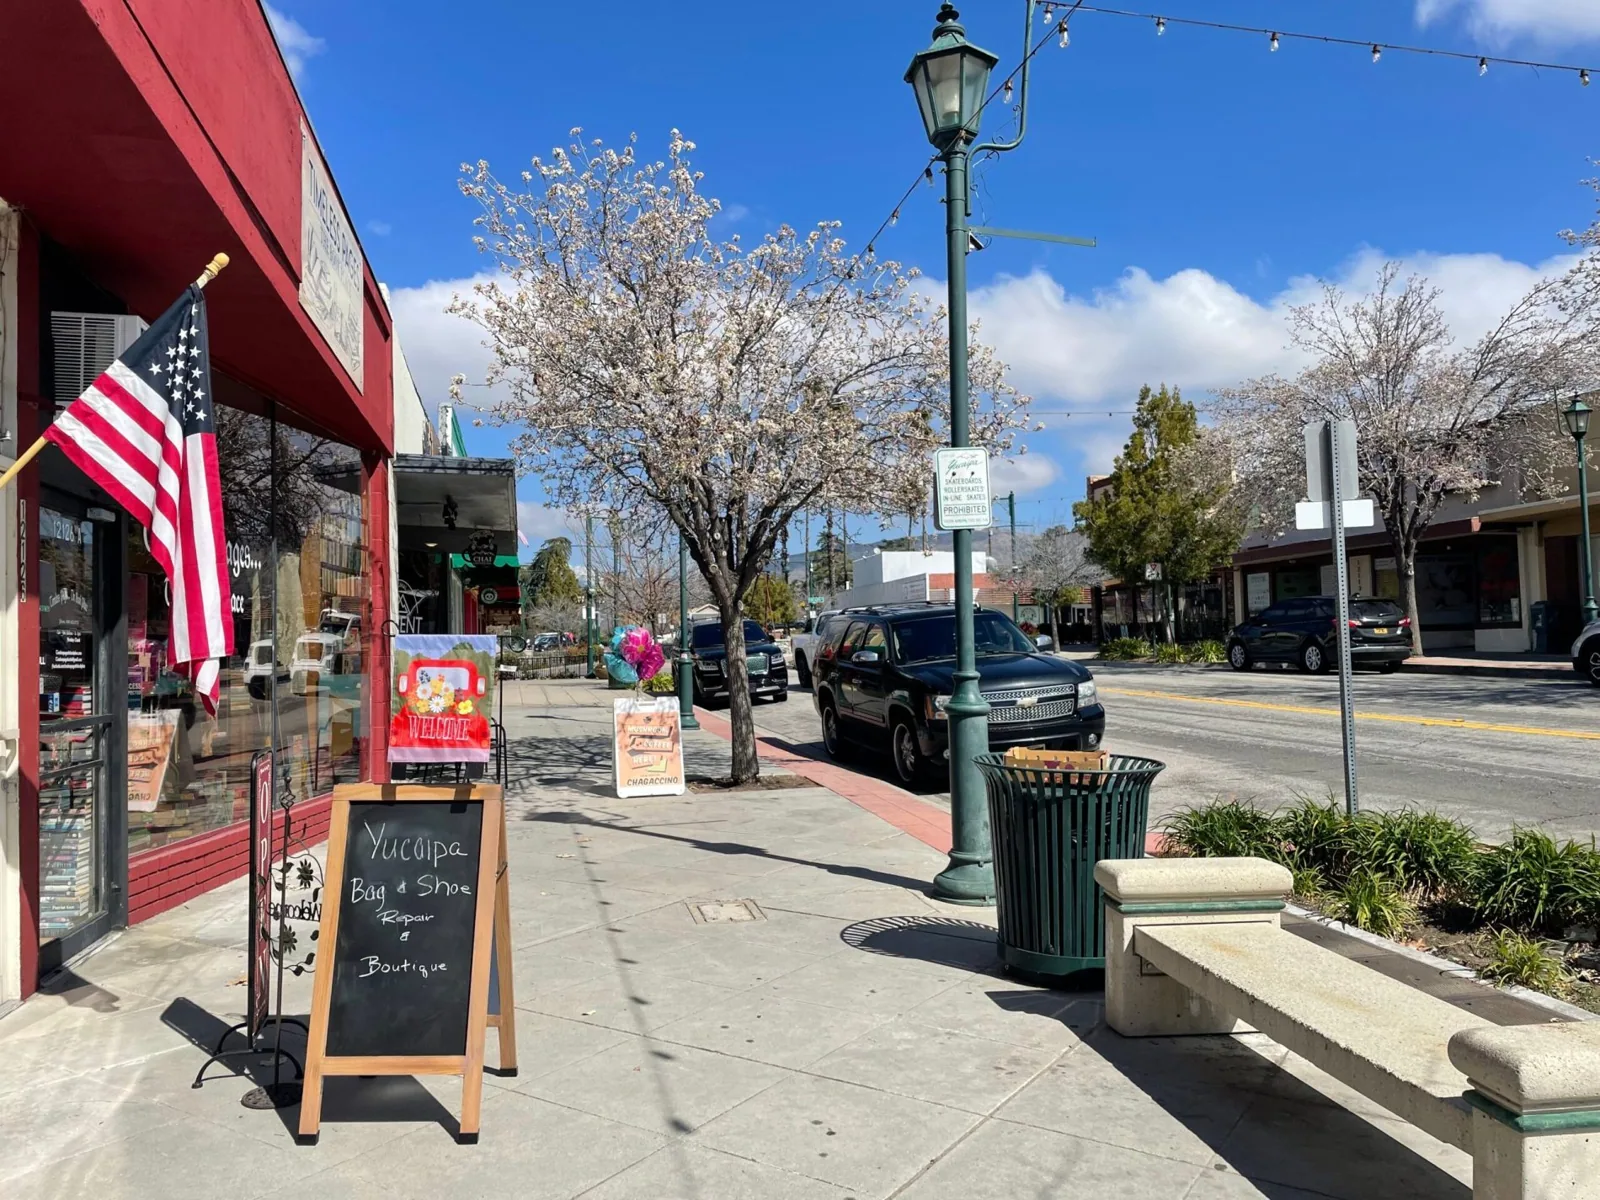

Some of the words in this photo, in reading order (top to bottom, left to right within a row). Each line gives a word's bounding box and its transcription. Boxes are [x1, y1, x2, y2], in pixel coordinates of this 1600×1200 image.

[308, 158, 341, 254] TIMELESS
[341, 230, 360, 293] PAGES
[944, 506, 987, 514] PROHIBITED
[53, 521, 75, 542] 12126
[226, 540, 262, 577] ages...
[231, 593, 245, 613] ace
[408, 715, 471, 741] WELCOME
[627, 776, 679, 786] CHAGACCINO
[364, 821, 468, 868] Yucaipa
[350, 878, 386, 912] Bag
[417, 874, 472, 896] Shoe
[377, 910, 434, 926] Repair
[359, 955, 448, 978] Boutique
